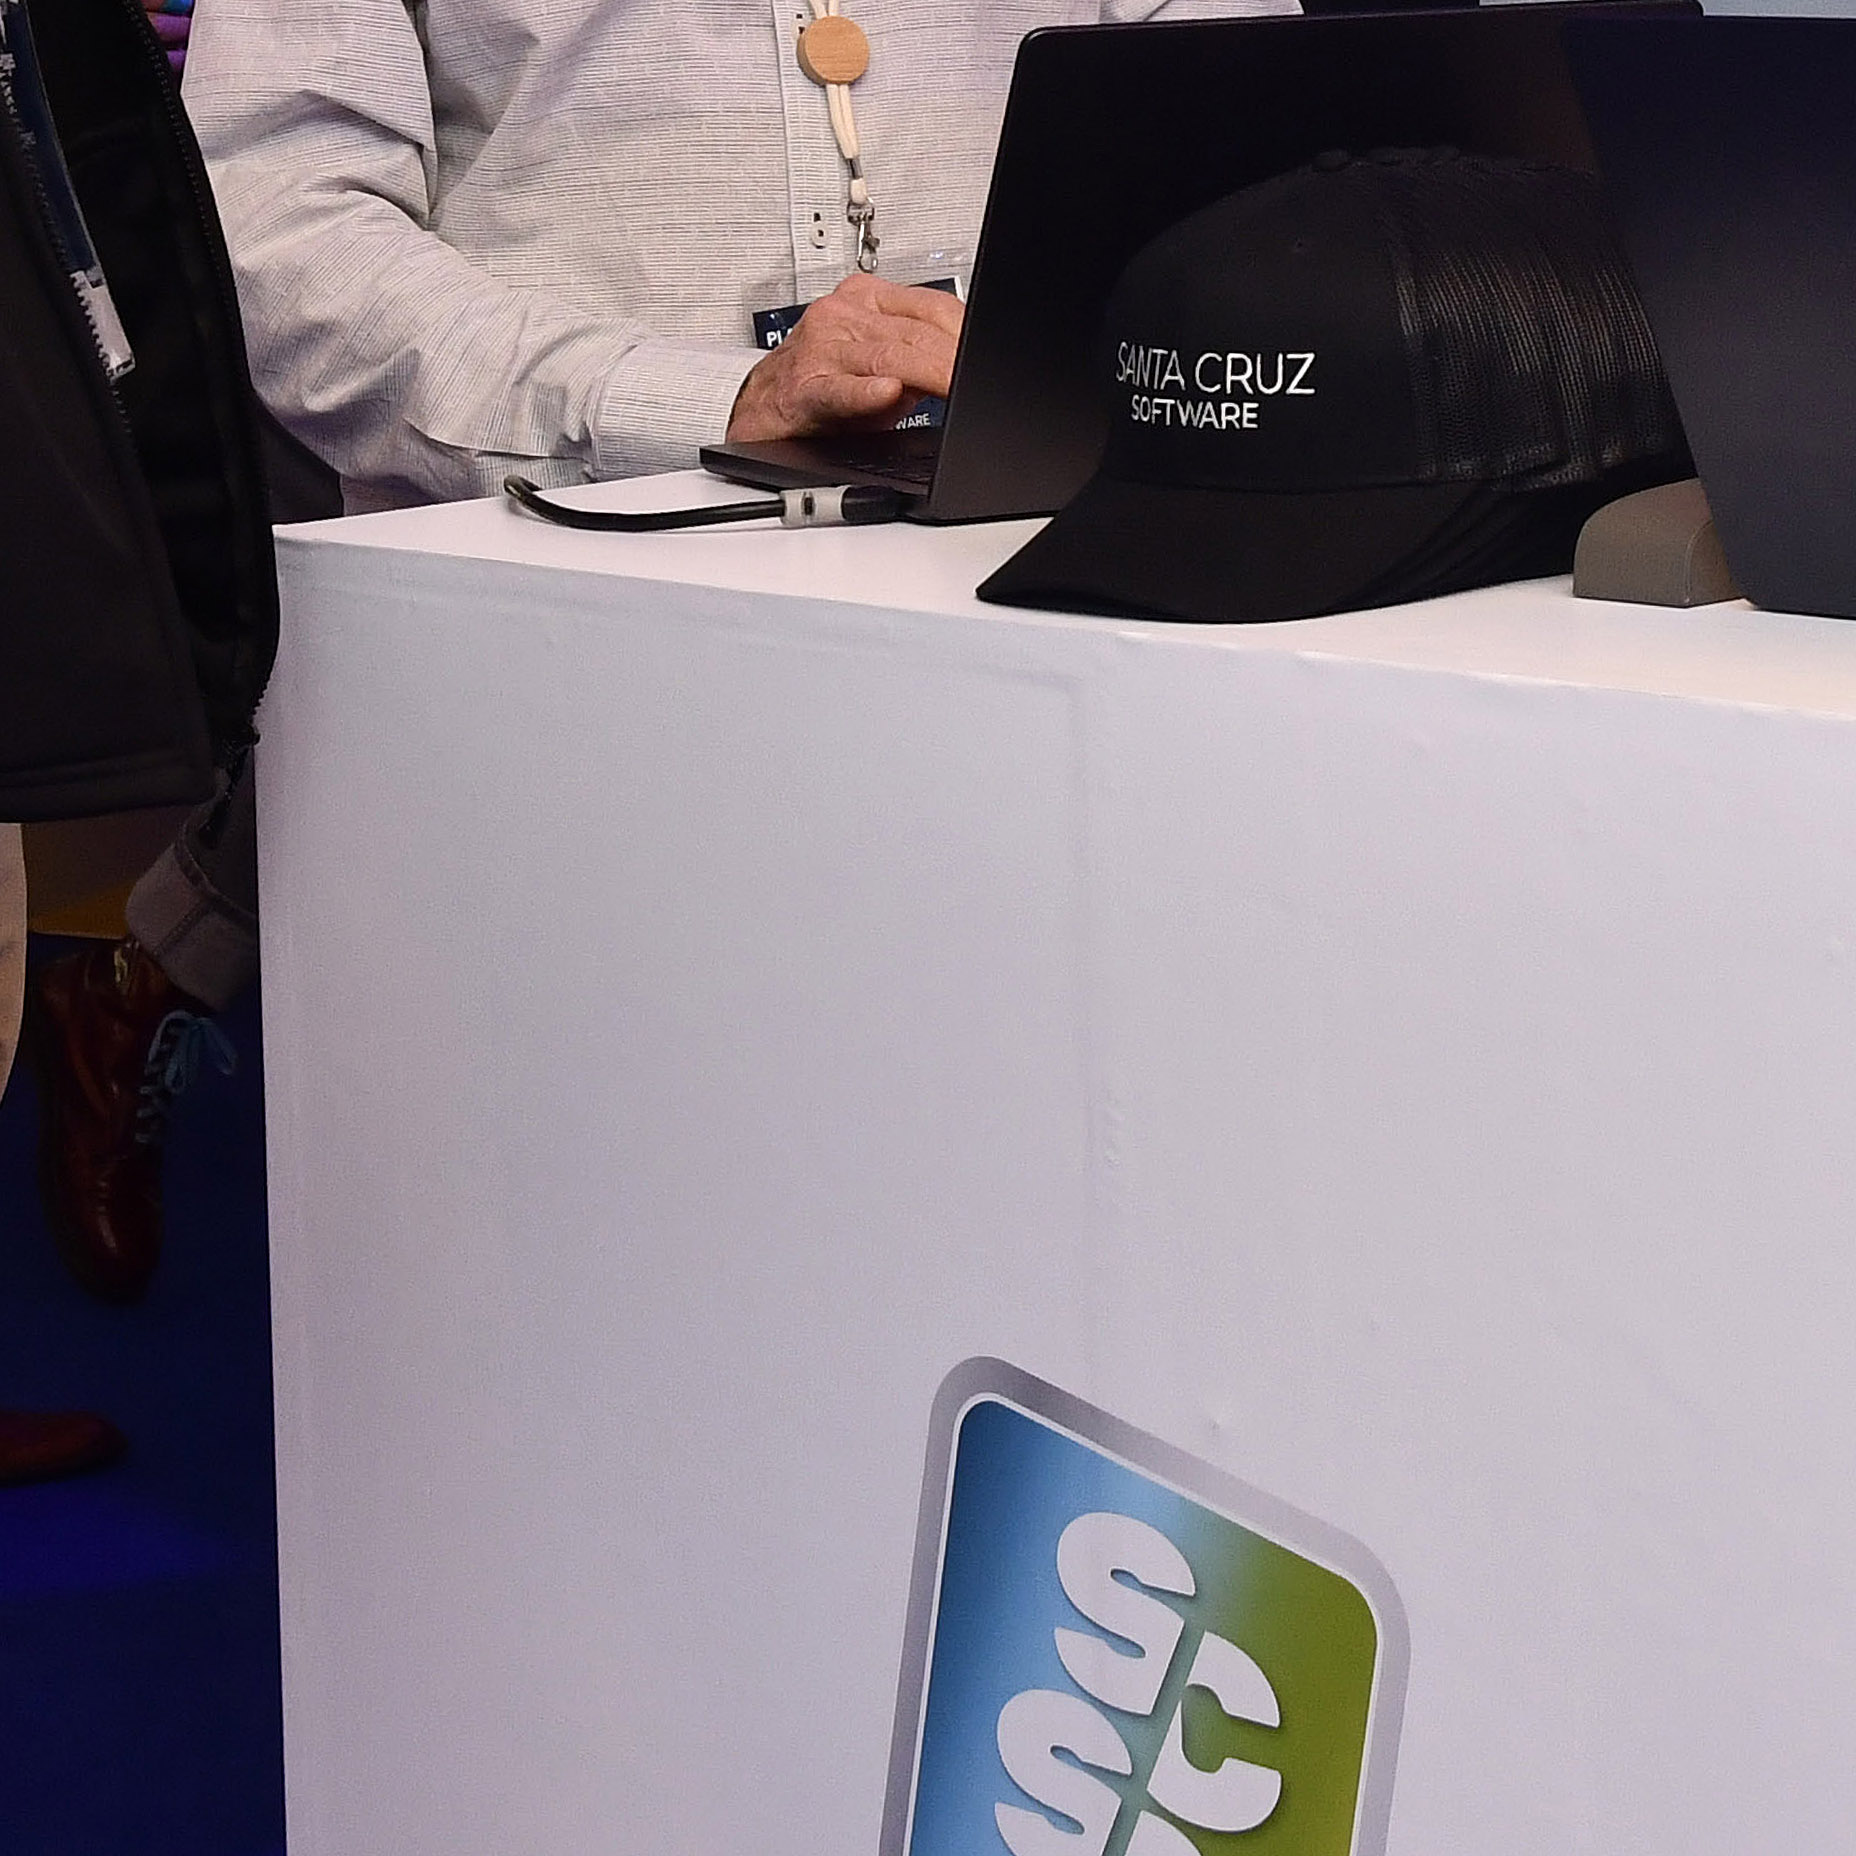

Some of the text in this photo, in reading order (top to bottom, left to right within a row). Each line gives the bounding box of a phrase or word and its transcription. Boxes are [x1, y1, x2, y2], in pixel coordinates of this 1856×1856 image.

[1116, 341, 1316, 395] SANTA CRUZ
[895, 412, 932, 431] WARE
[1131, 394, 1260, 431] SOFTWARE
